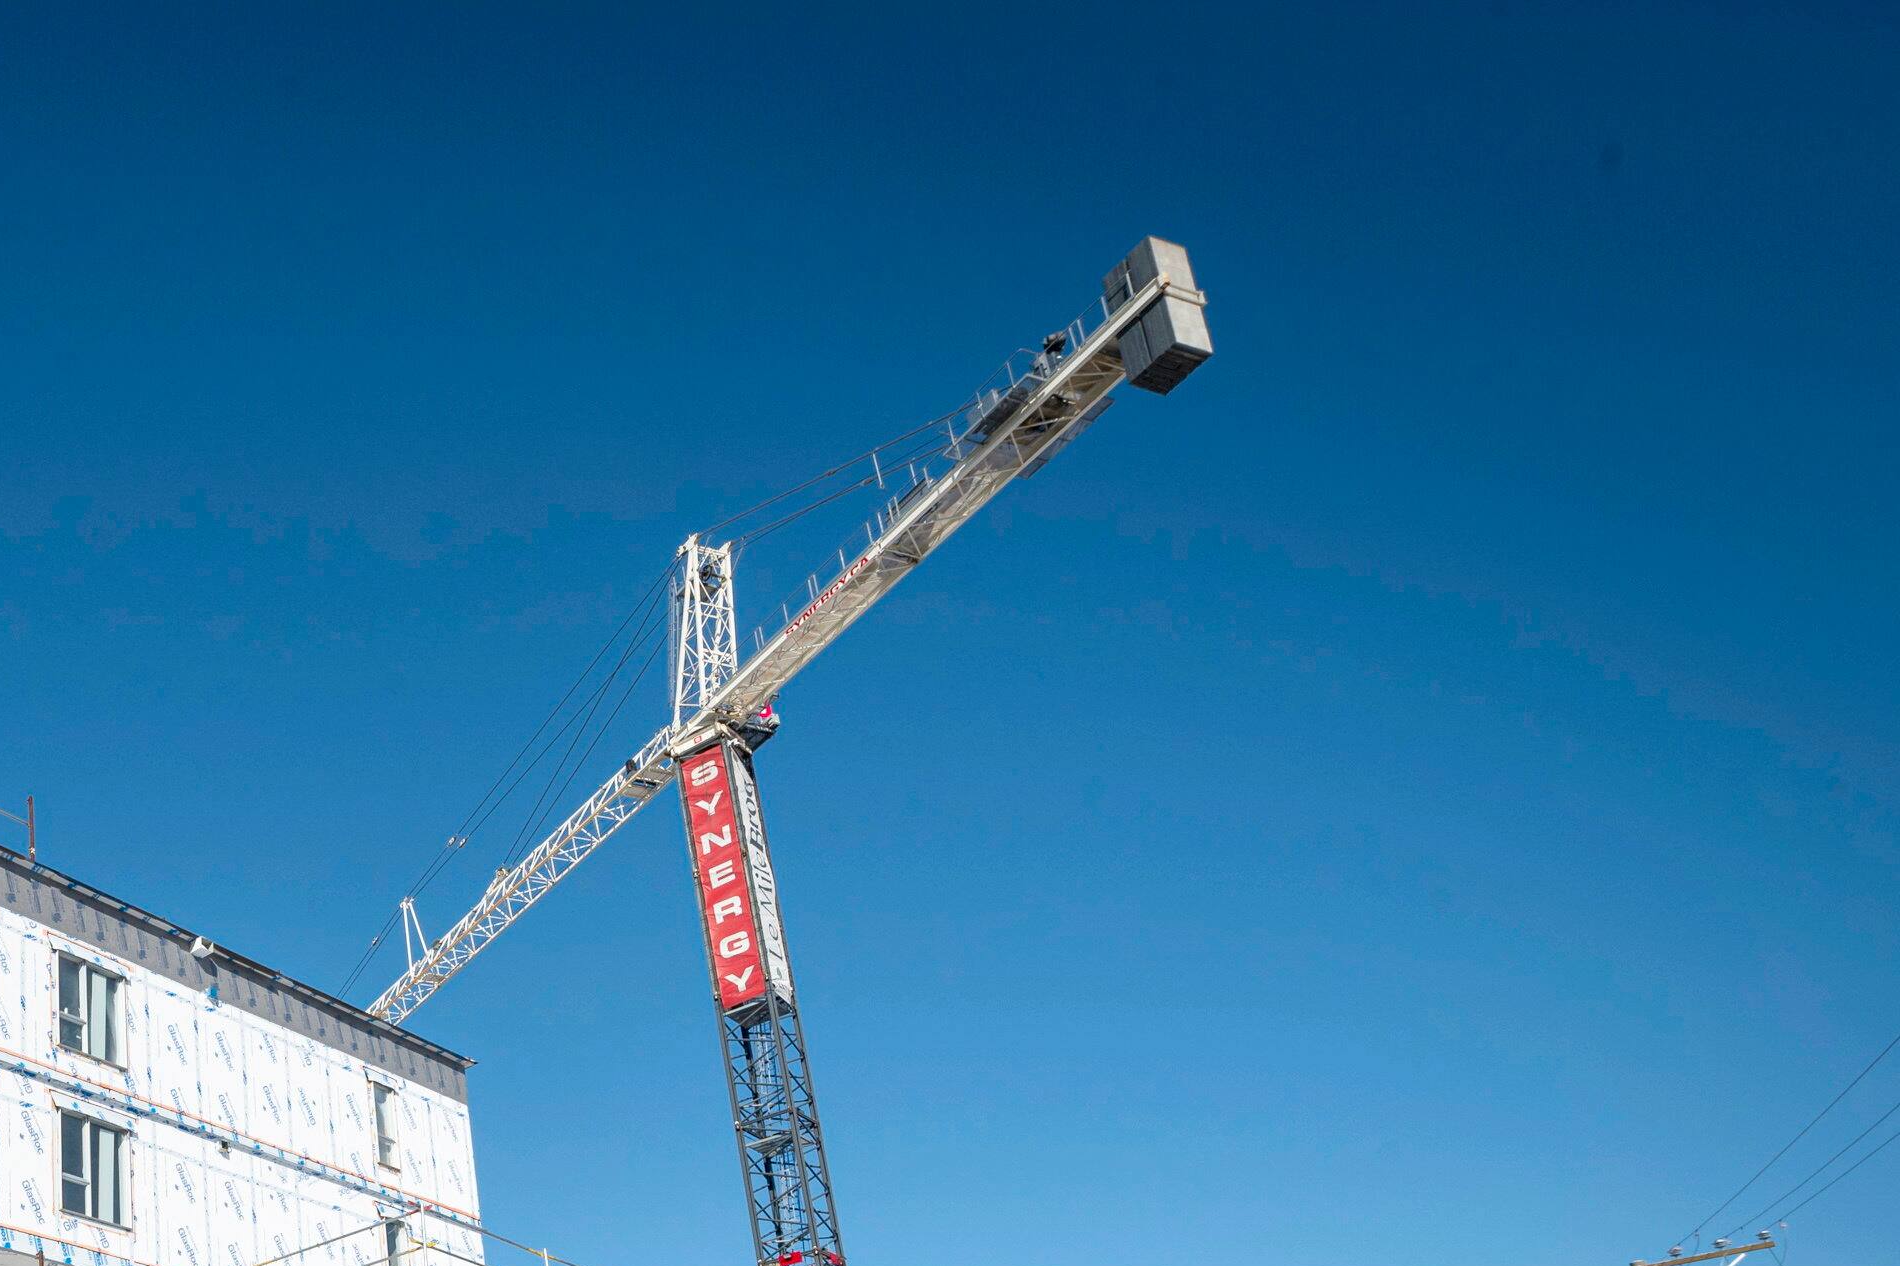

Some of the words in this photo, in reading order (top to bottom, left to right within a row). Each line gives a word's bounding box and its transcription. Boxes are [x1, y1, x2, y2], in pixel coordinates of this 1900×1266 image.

[691, 760, 754, 992] SYNERGY
[744, 781, 778, 916] MileBroo
[767, 924, 784, 963] Le
[22, 1179, 45, 1225] GlasRoc
